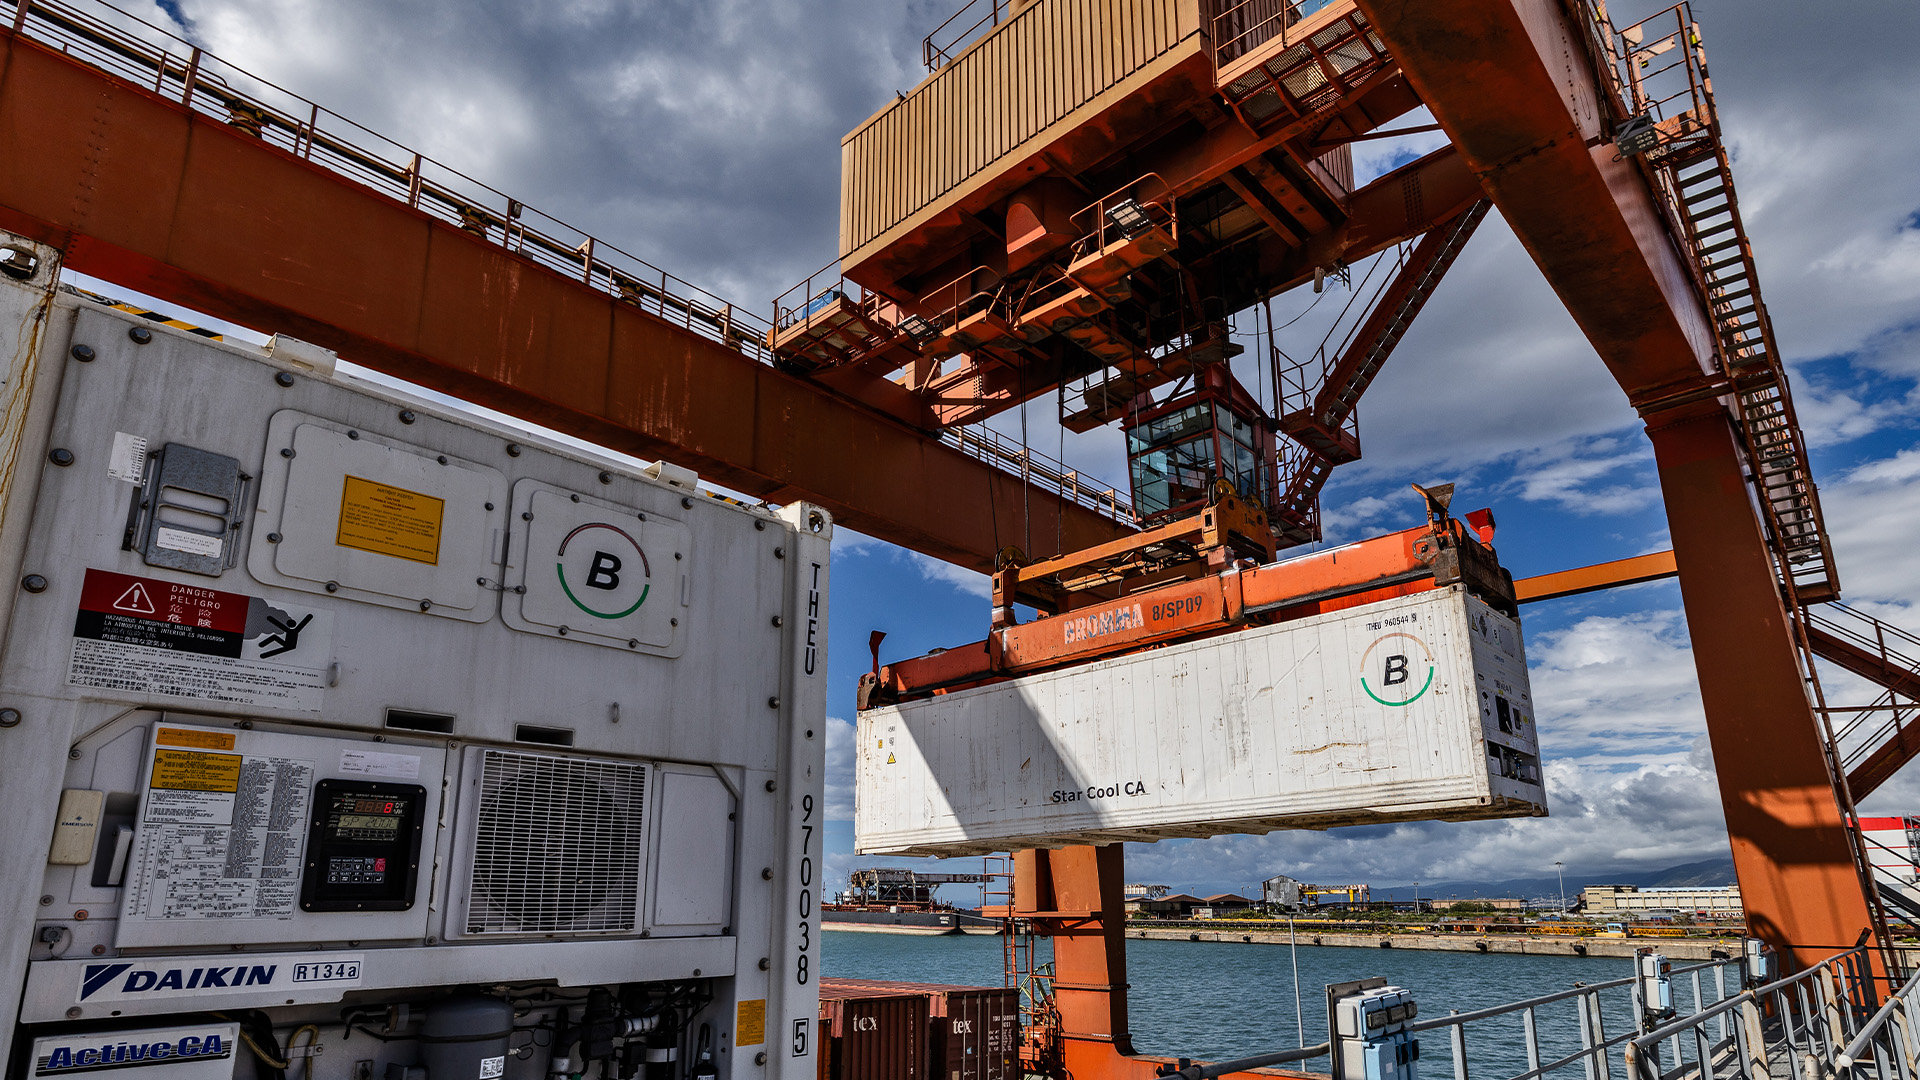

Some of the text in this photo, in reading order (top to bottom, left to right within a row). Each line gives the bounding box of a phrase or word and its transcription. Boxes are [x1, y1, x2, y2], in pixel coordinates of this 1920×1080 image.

[586, 551, 622, 590] B
[171, 585, 215, 598] DANGER
[170, 595, 220, 610] PELIGRO
[105, 614, 136, 623] HAZARDOUS
[1064, 595, 1202, 644] BROMMA 8/SP09
[1367, 621, 1381, 631] THEU
[1385, 615, 1408, 627] 960544
[1384, 655, 1408, 686] B
[1052, 781, 1145, 803] Star Cool CA
[795, 562, 820, 1053] THEU 970038 5
[123, 965, 359, 992] DAIKIN R134a
[853, 1014, 878, 1032] tex
[953, 1017, 972, 1034] tex
